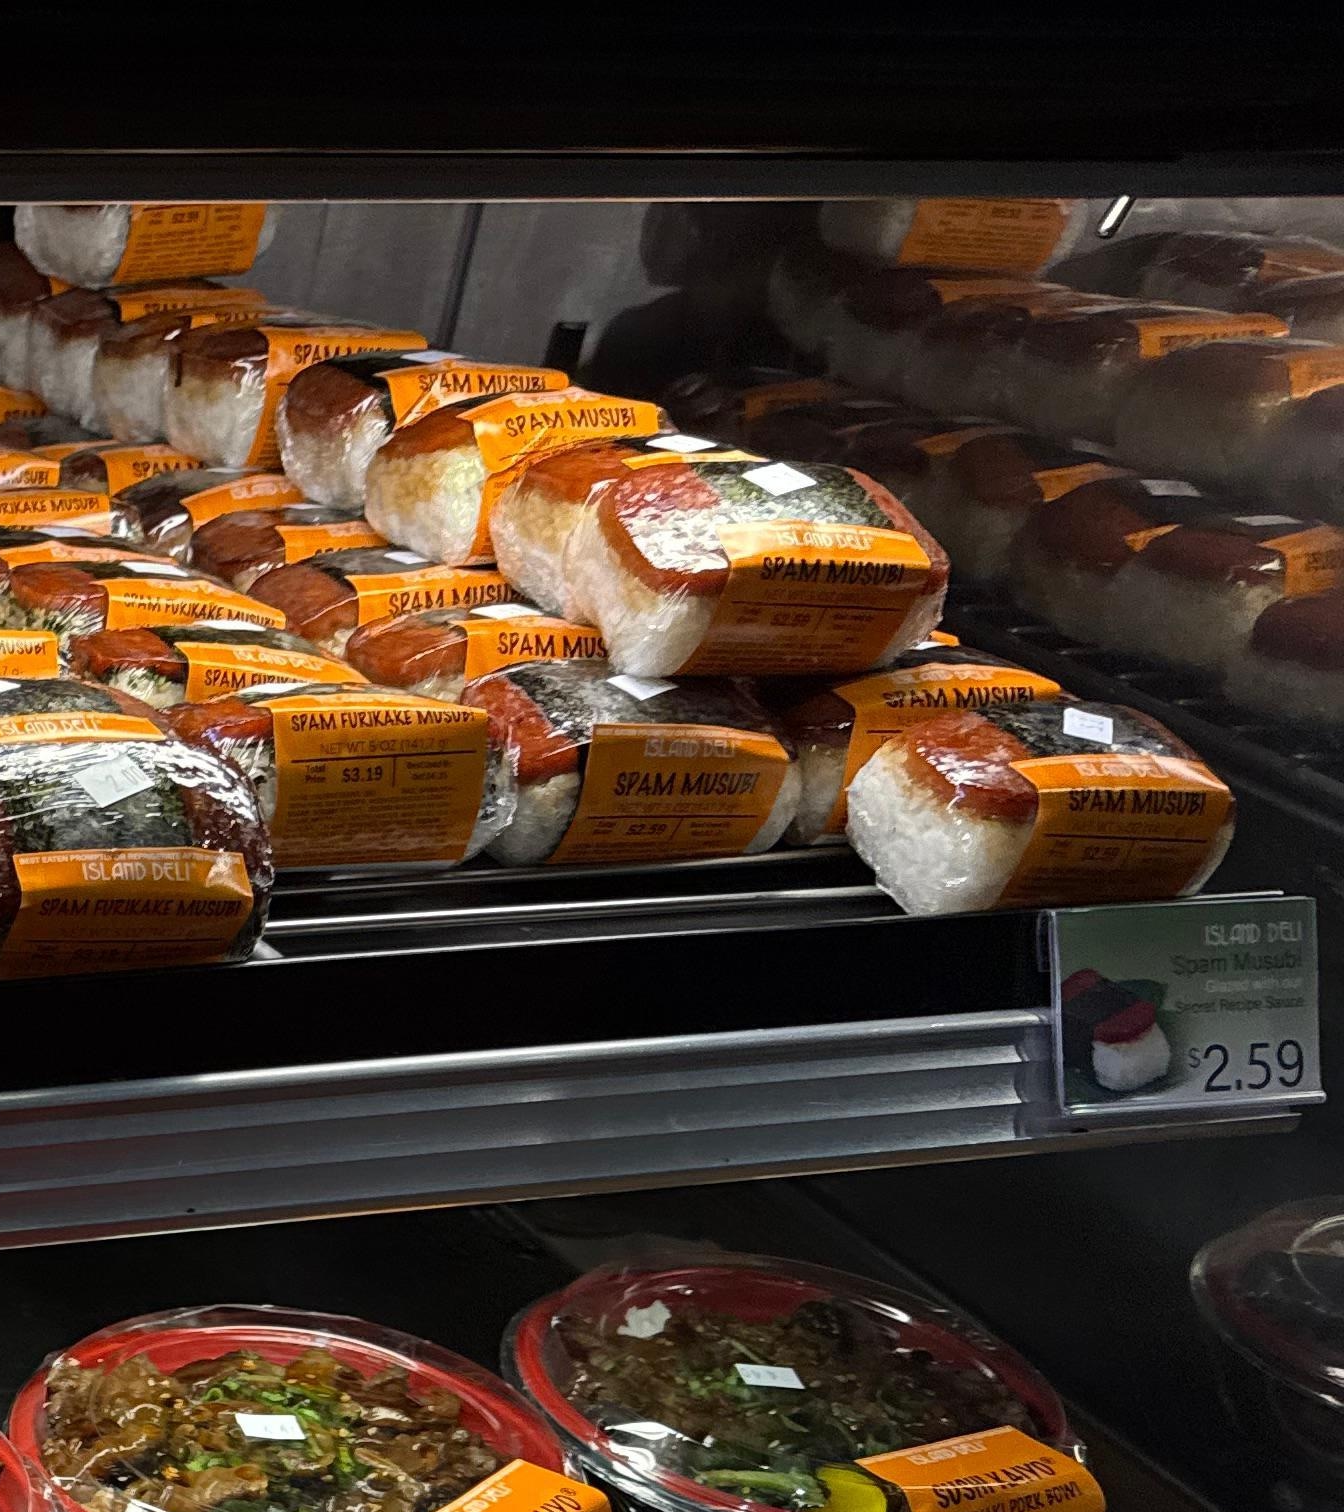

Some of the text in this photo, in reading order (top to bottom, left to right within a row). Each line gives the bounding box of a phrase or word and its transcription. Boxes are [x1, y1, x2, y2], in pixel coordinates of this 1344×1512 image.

[419, 373, 547, 394] SPAM MUSUBI
[506, 406, 637, 438] SPAM MUSUBI
[49, 496, 101, 512] MUSUBI
[762, 556, 905, 586] SPAM MUSUBI
[388, 589, 445, 616] SPAM
[204, 668, 246, 687] SPAM
[885, 685, 1035, 710] SPAM MUSUBI
[291, 710, 476, 732] SPAM FURIKAKE MUSUBI
[341, 766, 385, 784] $3.19
[614, 771, 761, 798] SPAM MUSUBI
[1069, 789, 1207, 817] SPAM MUSUBI
[39, 898, 242, 919] SPAM FURIKAKE MUSUBI
[1266, 920, 1303, 943] DELI
[1170, 948, 1302, 976] Spam Musubi
[1188, 1040, 1305, 1092] $2.59
[1046, 1480, 1084, 1506] BOWL
